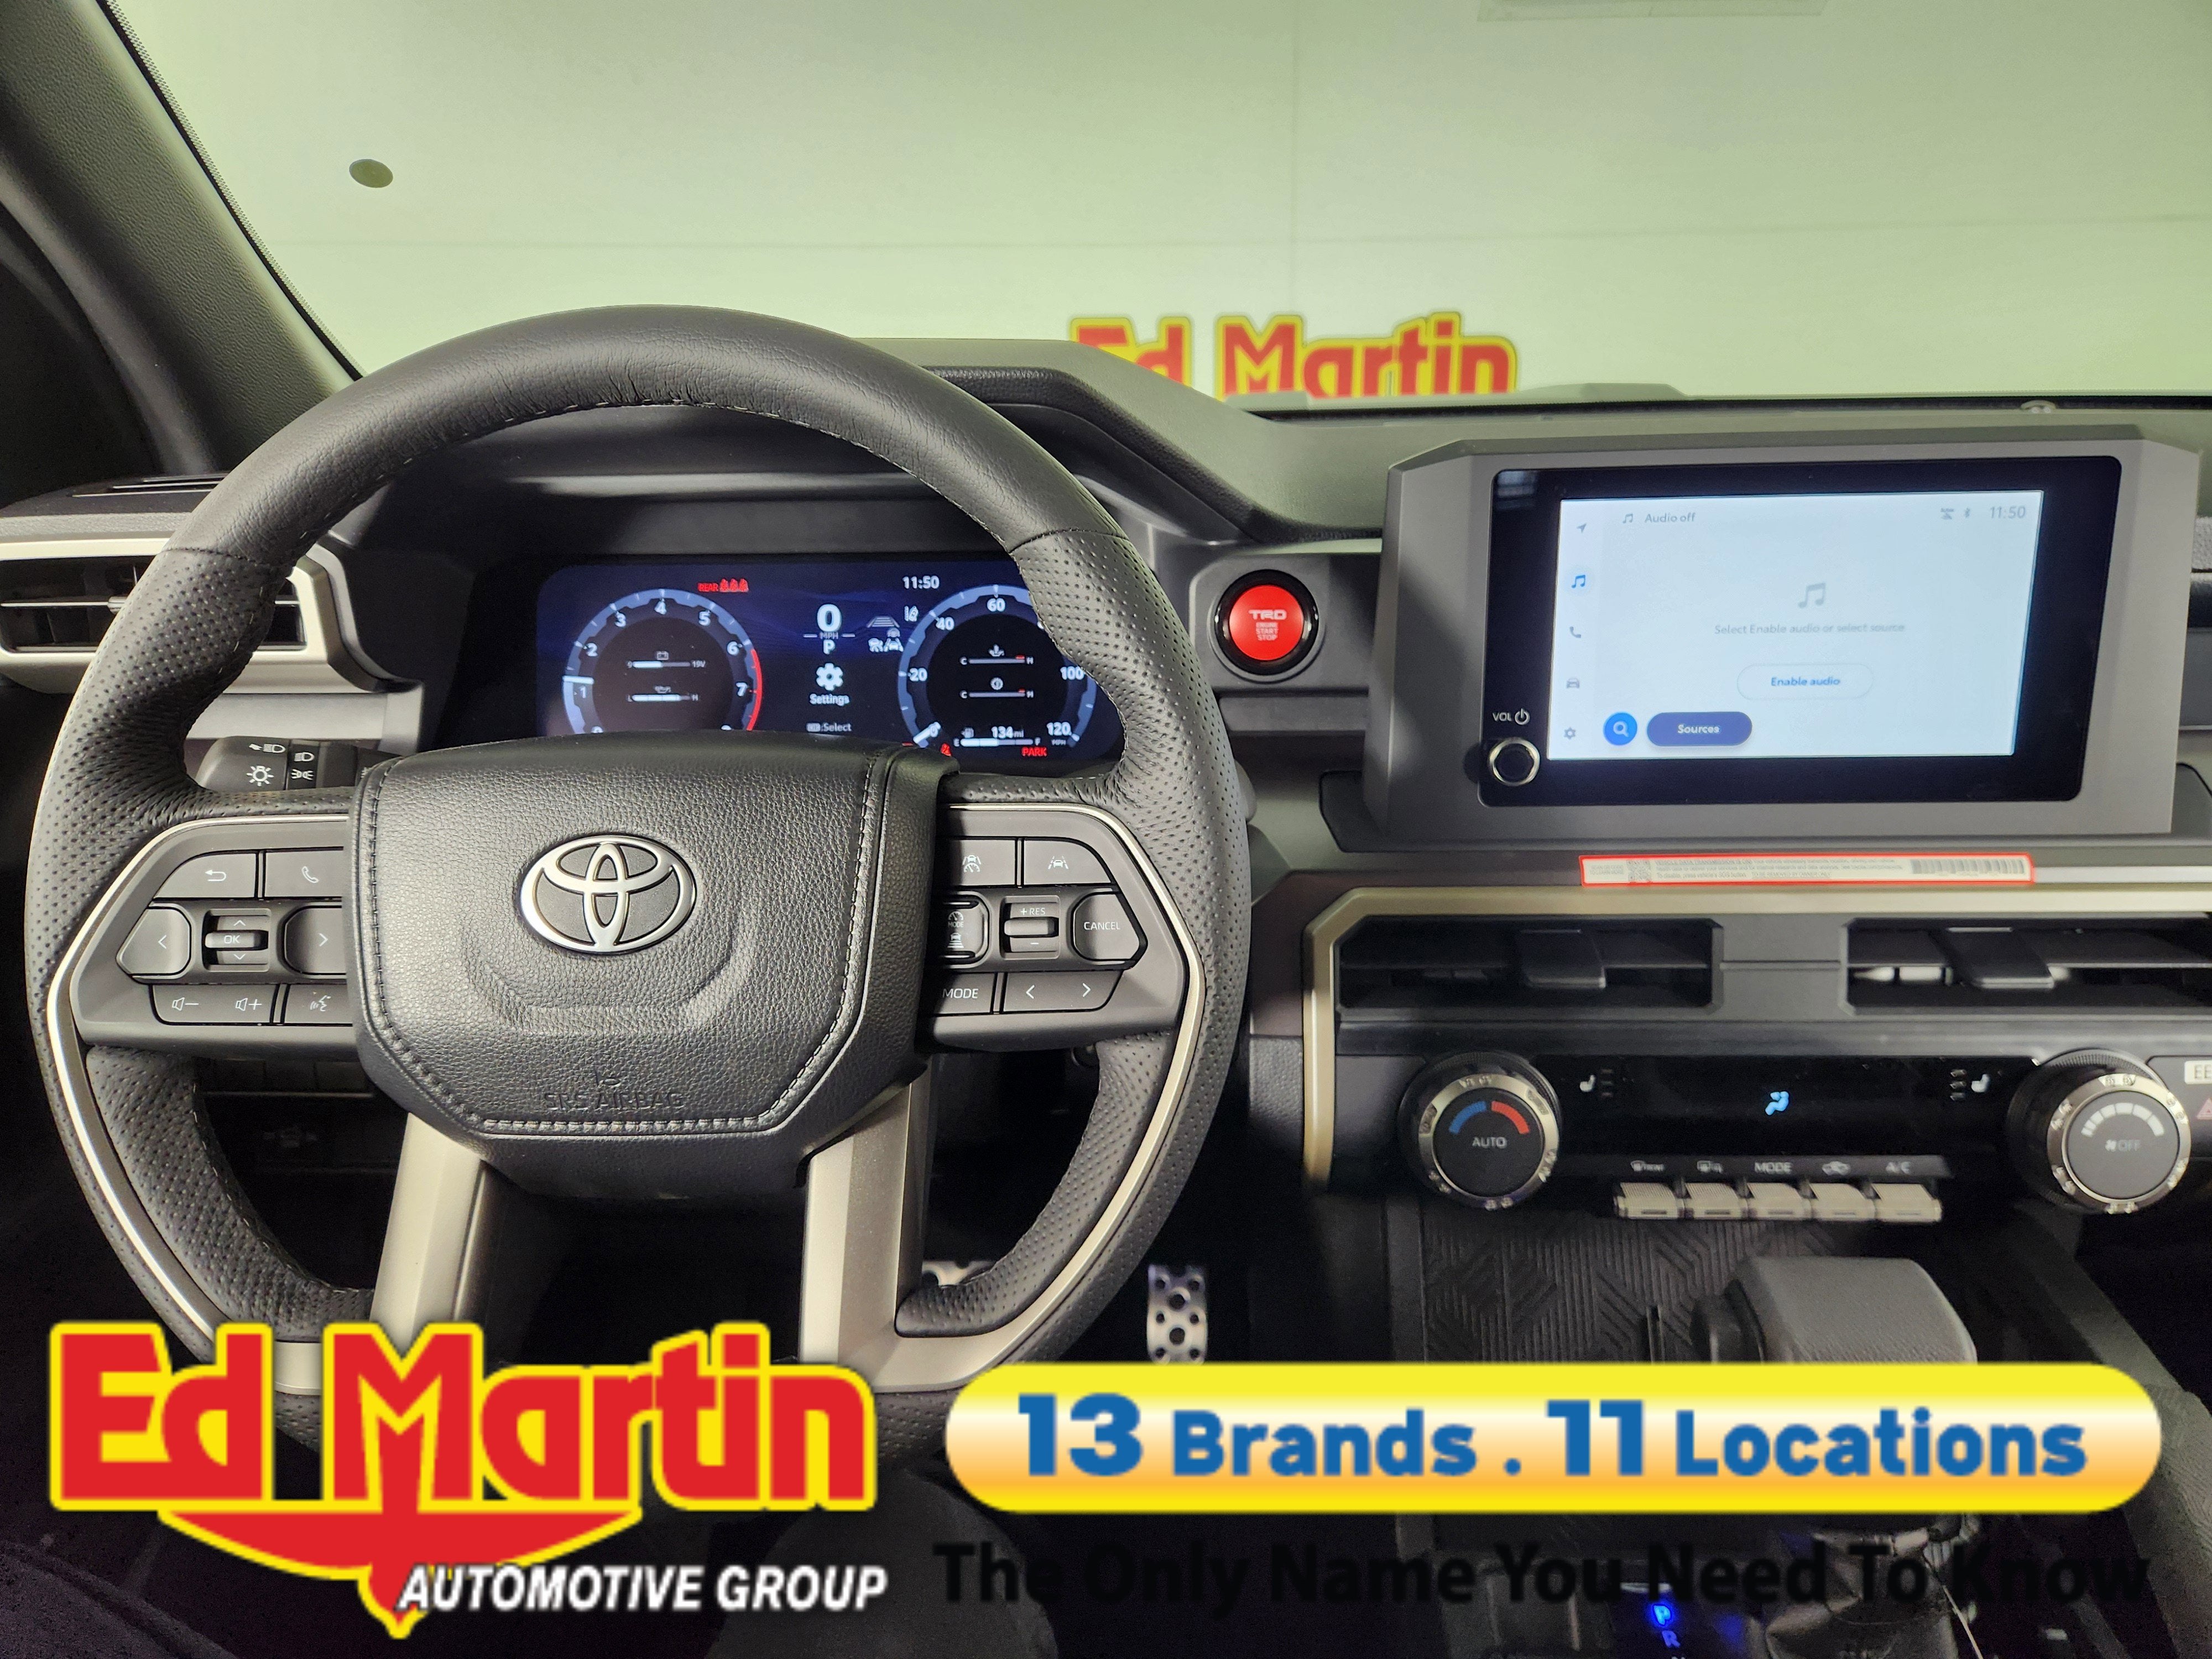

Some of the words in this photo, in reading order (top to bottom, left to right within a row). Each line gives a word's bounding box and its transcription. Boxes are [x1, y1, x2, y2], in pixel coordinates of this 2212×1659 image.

[1219, 315, 1514, 399] Martin
[1644, 513, 1678, 524] Audio
[1679, 512, 1696, 523] off
[1990, 505, 2026, 519] 11:50
[698, 582, 719, 592] REAR
[902, 575, 940, 589] 11:50
[654, 599, 667, 615] 4
[987, 598, 1006, 612] 60
[615, 612, 627, 627] 3
[698, 611, 711, 626] 5
[816, 603, 842, 632] 0
[1248, 609, 1287, 620] TRD
[936, 617, 955, 630] 40
[1714, 623, 1747, 635] Select
[1749, 623, 1787, 634] Enable
[1789, 623, 1820, 634] audio
[1822, 624, 1834, 633] or
[1836, 622, 1868, 633] select
[1869, 623, 1906, 633] source
[586, 643, 598, 657] 2
[727, 641, 739, 655] 6
[823, 639, 836, 655] P
[909, 667, 928, 682] 20
[1060, 666, 1086, 680] 100
[1770, 676, 1808, 687] Enable
[1809, 676, 1841, 687] audio
[735, 682, 748, 697] 7
[809, 693, 851, 707] Settings
[1493, 712, 1512, 722] VOL
[1046, 722, 1072, 735] 120
[1677, 724, 1720, 734] Sources
[1021, 747, 1047, 757] PARK
[1083, 921, 1121, 931] CANCEL
[223, 935, 240, 944] OK
[942, 988, 979, 999] MODE
[543, 1092, 588, 1110] SRS
[596, 1092, 685, 1110] AIRBAG
[1472, 1136, 1508, 1149] AUTO
[2118, 1140, 2140, 1152] OFF
[1754, 1161, 1793, 1175] MODE
[1653, 1605, 1671, 1625] P
[1661, 1630, 1681, 1648] R
